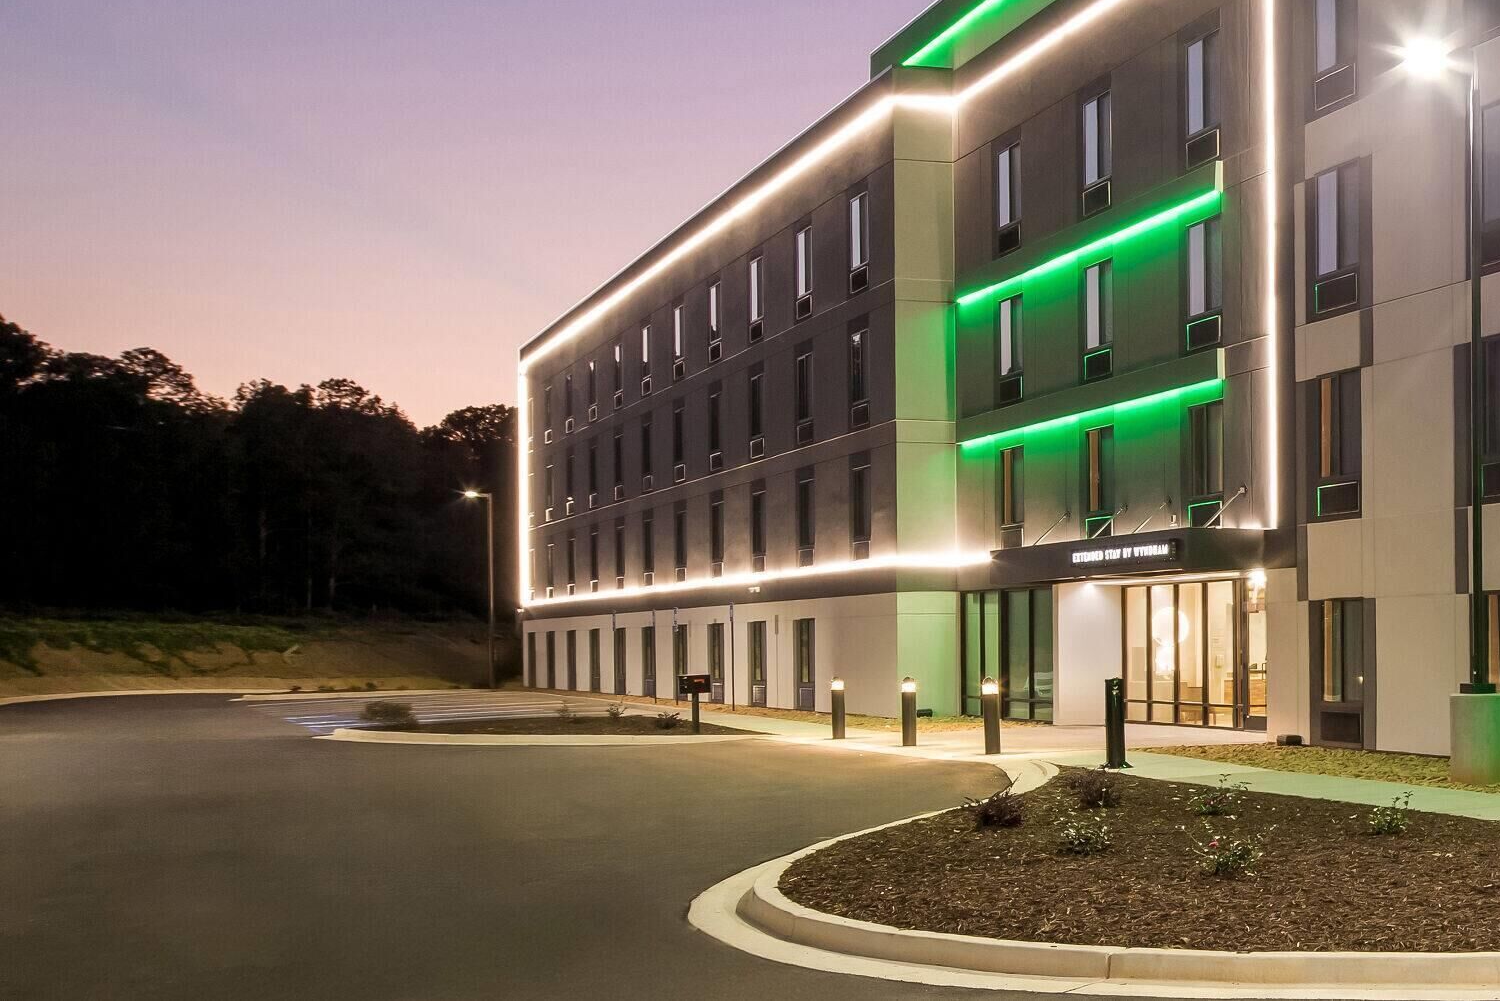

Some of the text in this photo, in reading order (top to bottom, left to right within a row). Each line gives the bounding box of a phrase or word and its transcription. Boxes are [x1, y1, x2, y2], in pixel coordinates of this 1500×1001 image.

[1072, 544, 1169, 563] EXTENDED STAY BY WYNDHAM
